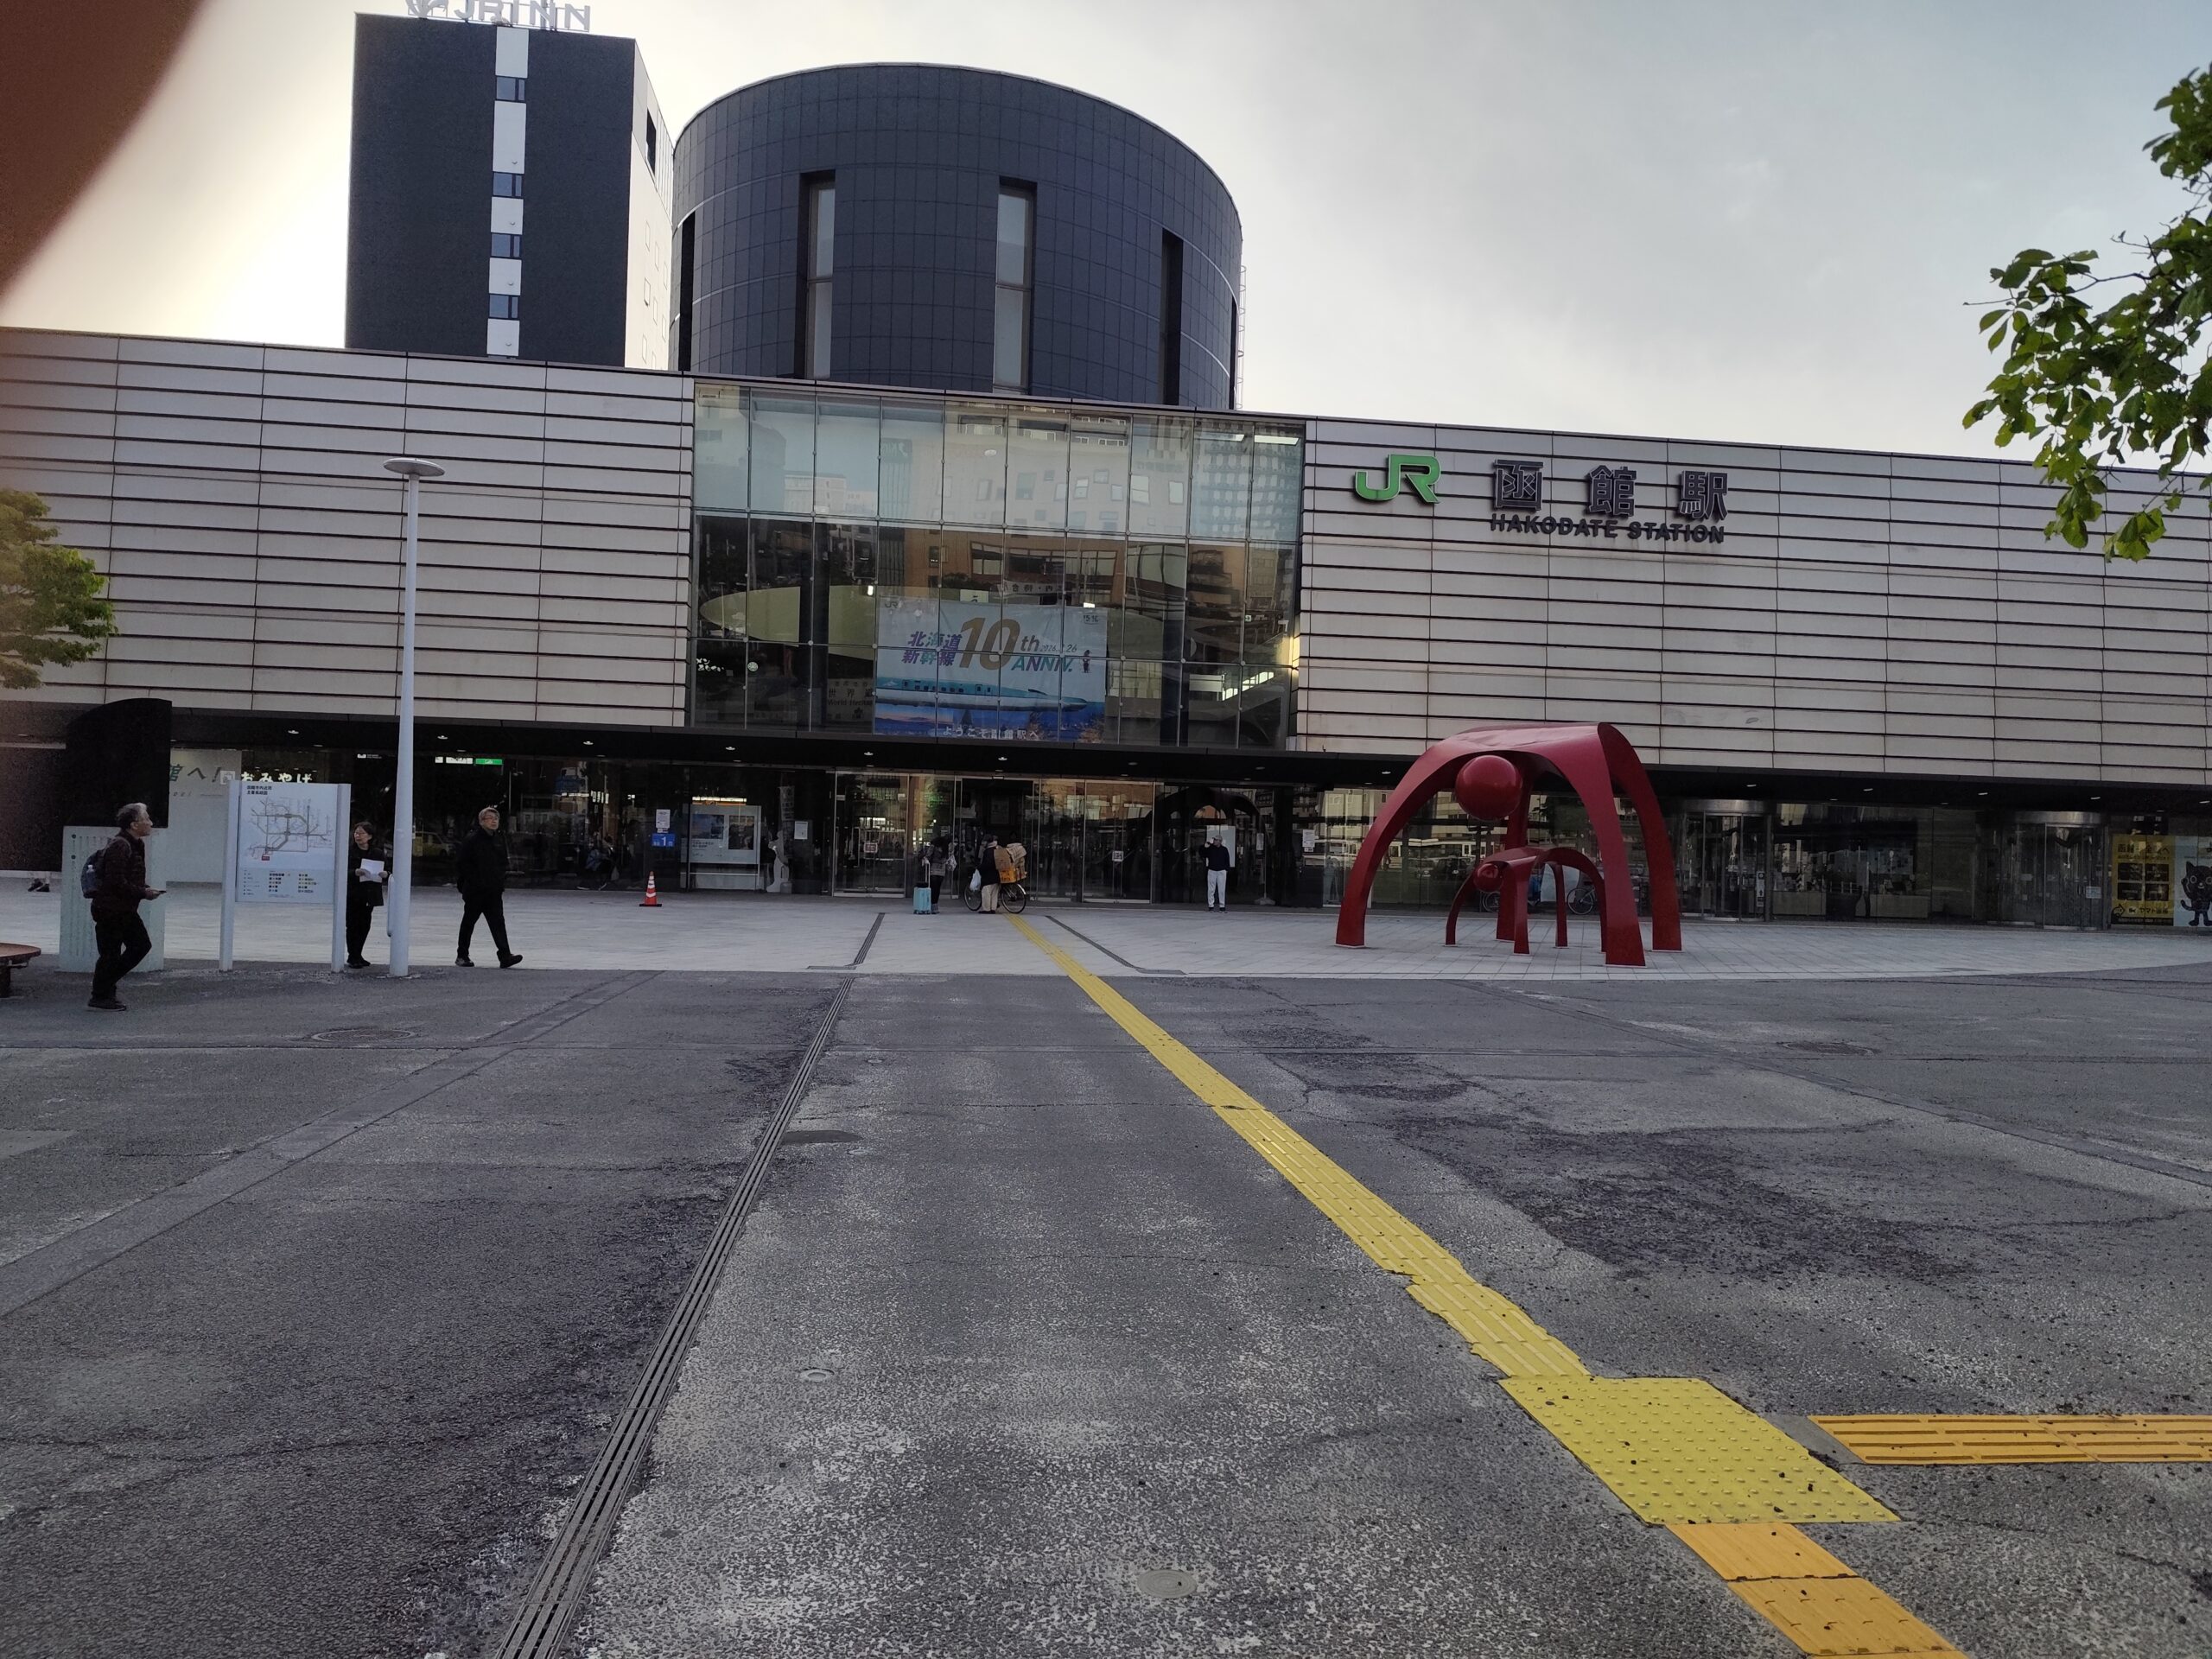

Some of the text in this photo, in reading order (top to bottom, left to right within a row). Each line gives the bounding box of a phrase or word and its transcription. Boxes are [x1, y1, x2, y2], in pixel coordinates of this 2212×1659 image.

[1355, 454, 1442, 504] JR
[1494, 459, 1728, 520] 函館駅
[1490, 513, 1726, 544] HAKODATE STATION
[907, 632, 962, 650] 北海道
[1039, 642, 1077, 653] 2026..26
[901, 650, 956, 666] 新幹線
[1011, 655, 1072, 672] ANNIV.
